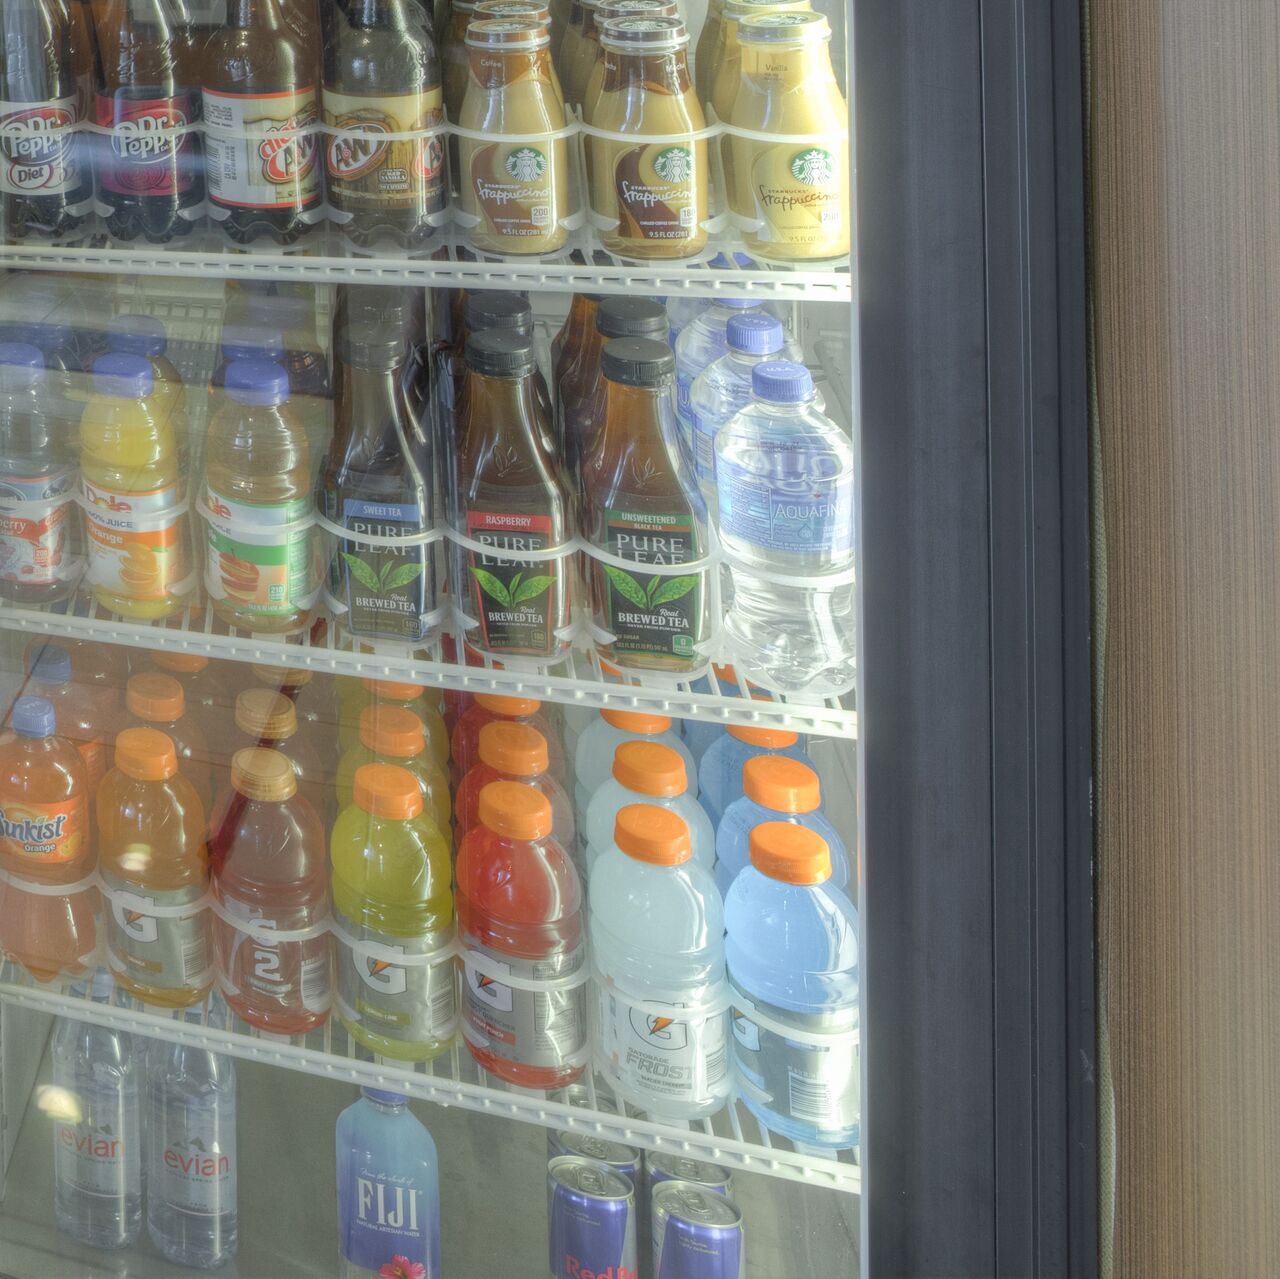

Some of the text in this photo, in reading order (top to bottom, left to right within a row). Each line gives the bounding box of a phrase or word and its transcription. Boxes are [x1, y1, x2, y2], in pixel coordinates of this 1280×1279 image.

[480, 59, 502, 68] Coffee
[764, 64, 788, 72] Vanilla
[17, 168, 44, 183] Diet
[477, 179, 551, 205] frappuccino
[759, 184, 839, 213] frappuccino
[533, 207, 548, 218] 200
[86, 482, 133, 514] Dole
[362, 505, 402, 518] SWEET TEA
[621, 512, 677, 525] UNSWEETENED
[105, 519, 133, 529] JUICE
[485, 516, 532, 527] RASPBERRY
[354, 522, 413, 538] PURE
[478, 535, 542, 552] PURE
[616, 533, 685, 554] PURE
[356, 596, 396, 611] BREWED
[394, 600, 416, 612] TEA
[488, 611, 544, 624] BREWED TEA
[618, 612, 689, 628] BREWED TEA
[660, 608, 679, 618] Real
[24, 841, 56, 854] Orange
[626, 1052, 693, 1079] FROST
[61, 1126, 125, 1159] evian
[163, 1147, 230, 1178] evian
[357, 1178, 419, 1231] FIJI
